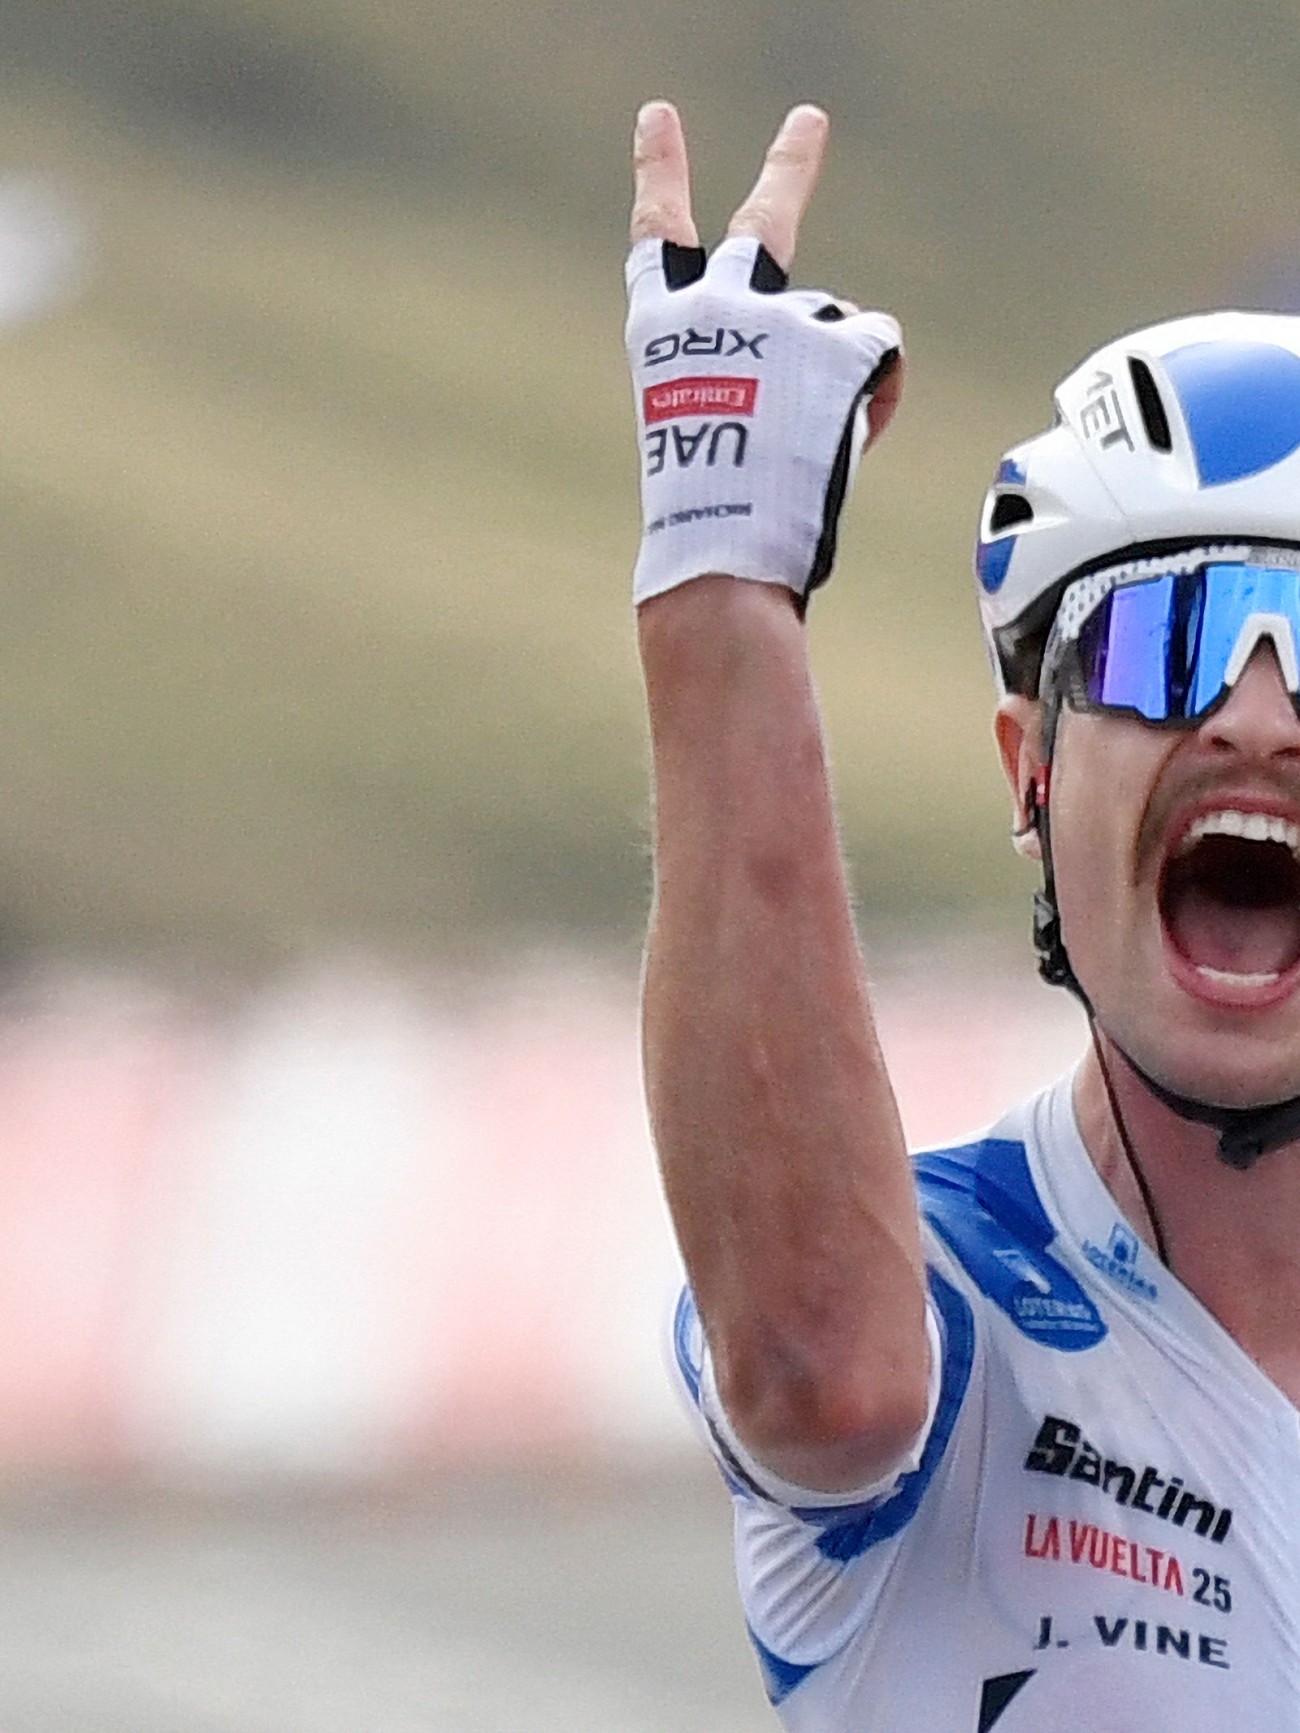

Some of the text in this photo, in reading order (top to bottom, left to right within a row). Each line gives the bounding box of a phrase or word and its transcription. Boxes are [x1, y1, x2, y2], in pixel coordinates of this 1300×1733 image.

[644, 327, 770, 367] XRG
[646, 422, 748, 477] UAE
[1023, 1414, 1233, 1545] Santini
[1024, 1513, 1233, 1614] LA VUELTA 25
[1033, 1615, 1231, 1670] J. VINE
